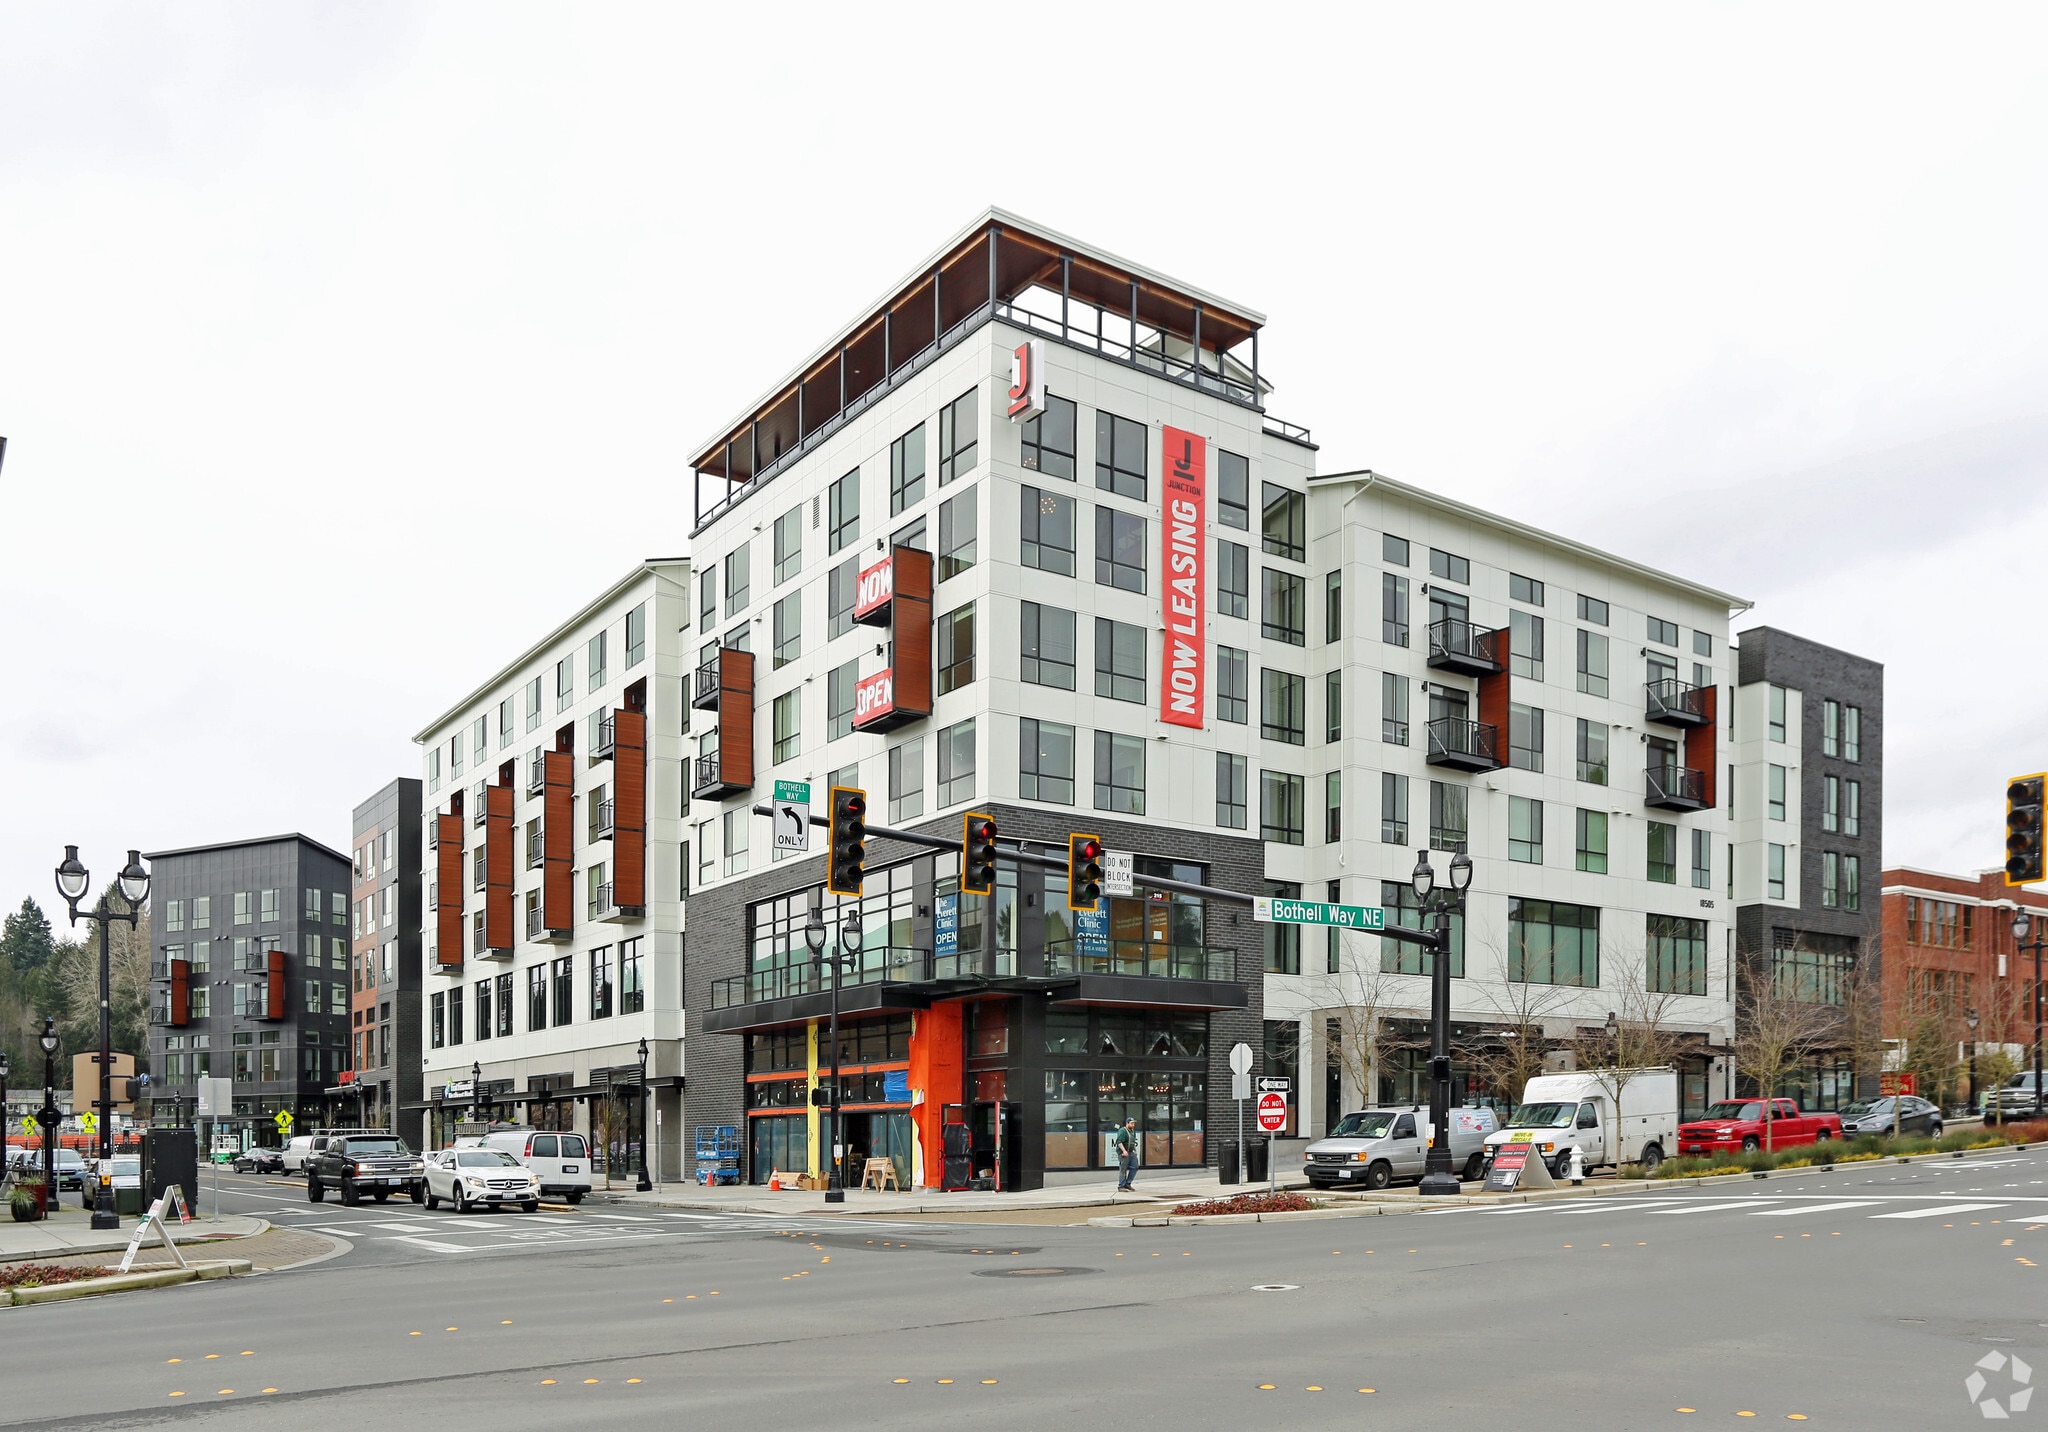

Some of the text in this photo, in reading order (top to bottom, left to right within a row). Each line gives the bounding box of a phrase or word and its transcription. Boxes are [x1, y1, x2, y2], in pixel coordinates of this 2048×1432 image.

[1173, 438, 1192, 471] J
[1167, 479, 1201, 496] JUNCTION
[857, 562, 892, 609] NOW
[1170, 499, 1197, 714] NOW LEASING
[856, 676, 892, 716] OPEN
[779, 782, 806, 793] BOTHELL
[785, 791, 800, 800] WAY
[778, 834, 804, 846] ONLY
[1107, 857, 1131, 869] DO NOT
[1107, 870, 1131, 882] BLOCK
[1107, 883, 1132, 891] INTERSECTION
[1700, 899, 1715, 909] 18505
[1274, 901, 1381, 927] Bothell Way NE
[936, 917, 953, 930] Clinic
[1077, 916, 1102, 929] Clinic
[936, 930, 957, 945] OPEN
[1077, 931, 1107, 945] OPEN
